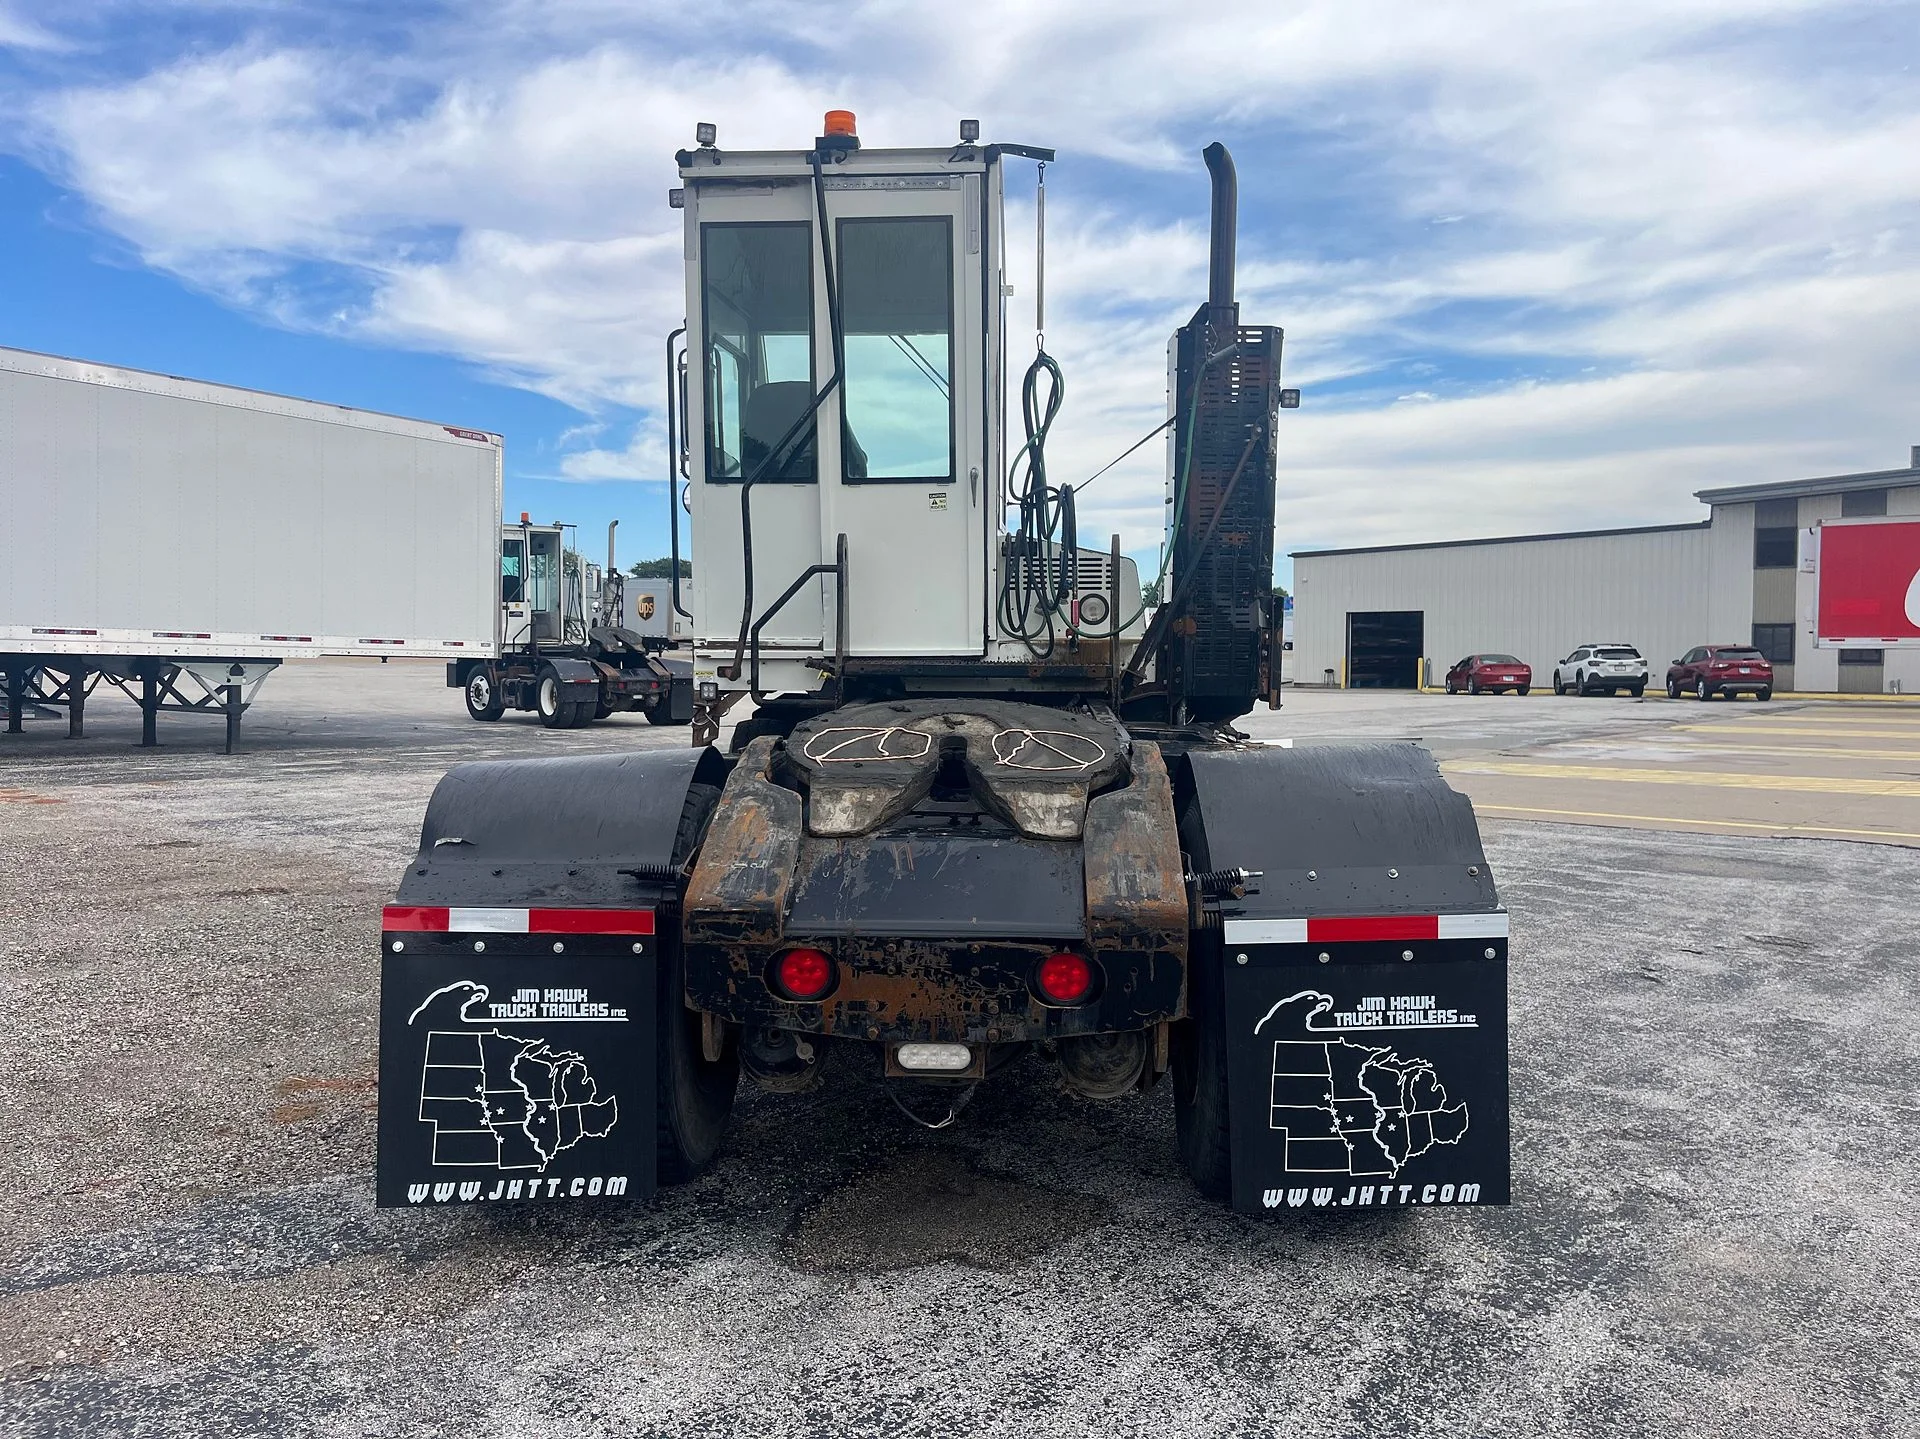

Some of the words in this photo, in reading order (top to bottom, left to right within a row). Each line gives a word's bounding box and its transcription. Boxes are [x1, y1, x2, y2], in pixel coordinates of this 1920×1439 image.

[638, 602, 654, 618] ups
[512, 988, 540, 1003] JIM
[543, 988, 588, 1003] HAWK
[1356, 997, 1386, 1012] JIM
[1389, 995, 1436, 1011] HAWK
[488, 1003, 537, 1018] TRUCK
[540, 1002, 609, 1018] TRAILERS
[1333, 1011, 1383, 1027] TRUCK
[1386, 1009, 1458, 1025] TRAILERS
[406, 1176, 628, 1204] WWW.JHTT.COM
[1262, 1183, 1481, 1209] WWW.JHTT.COM
